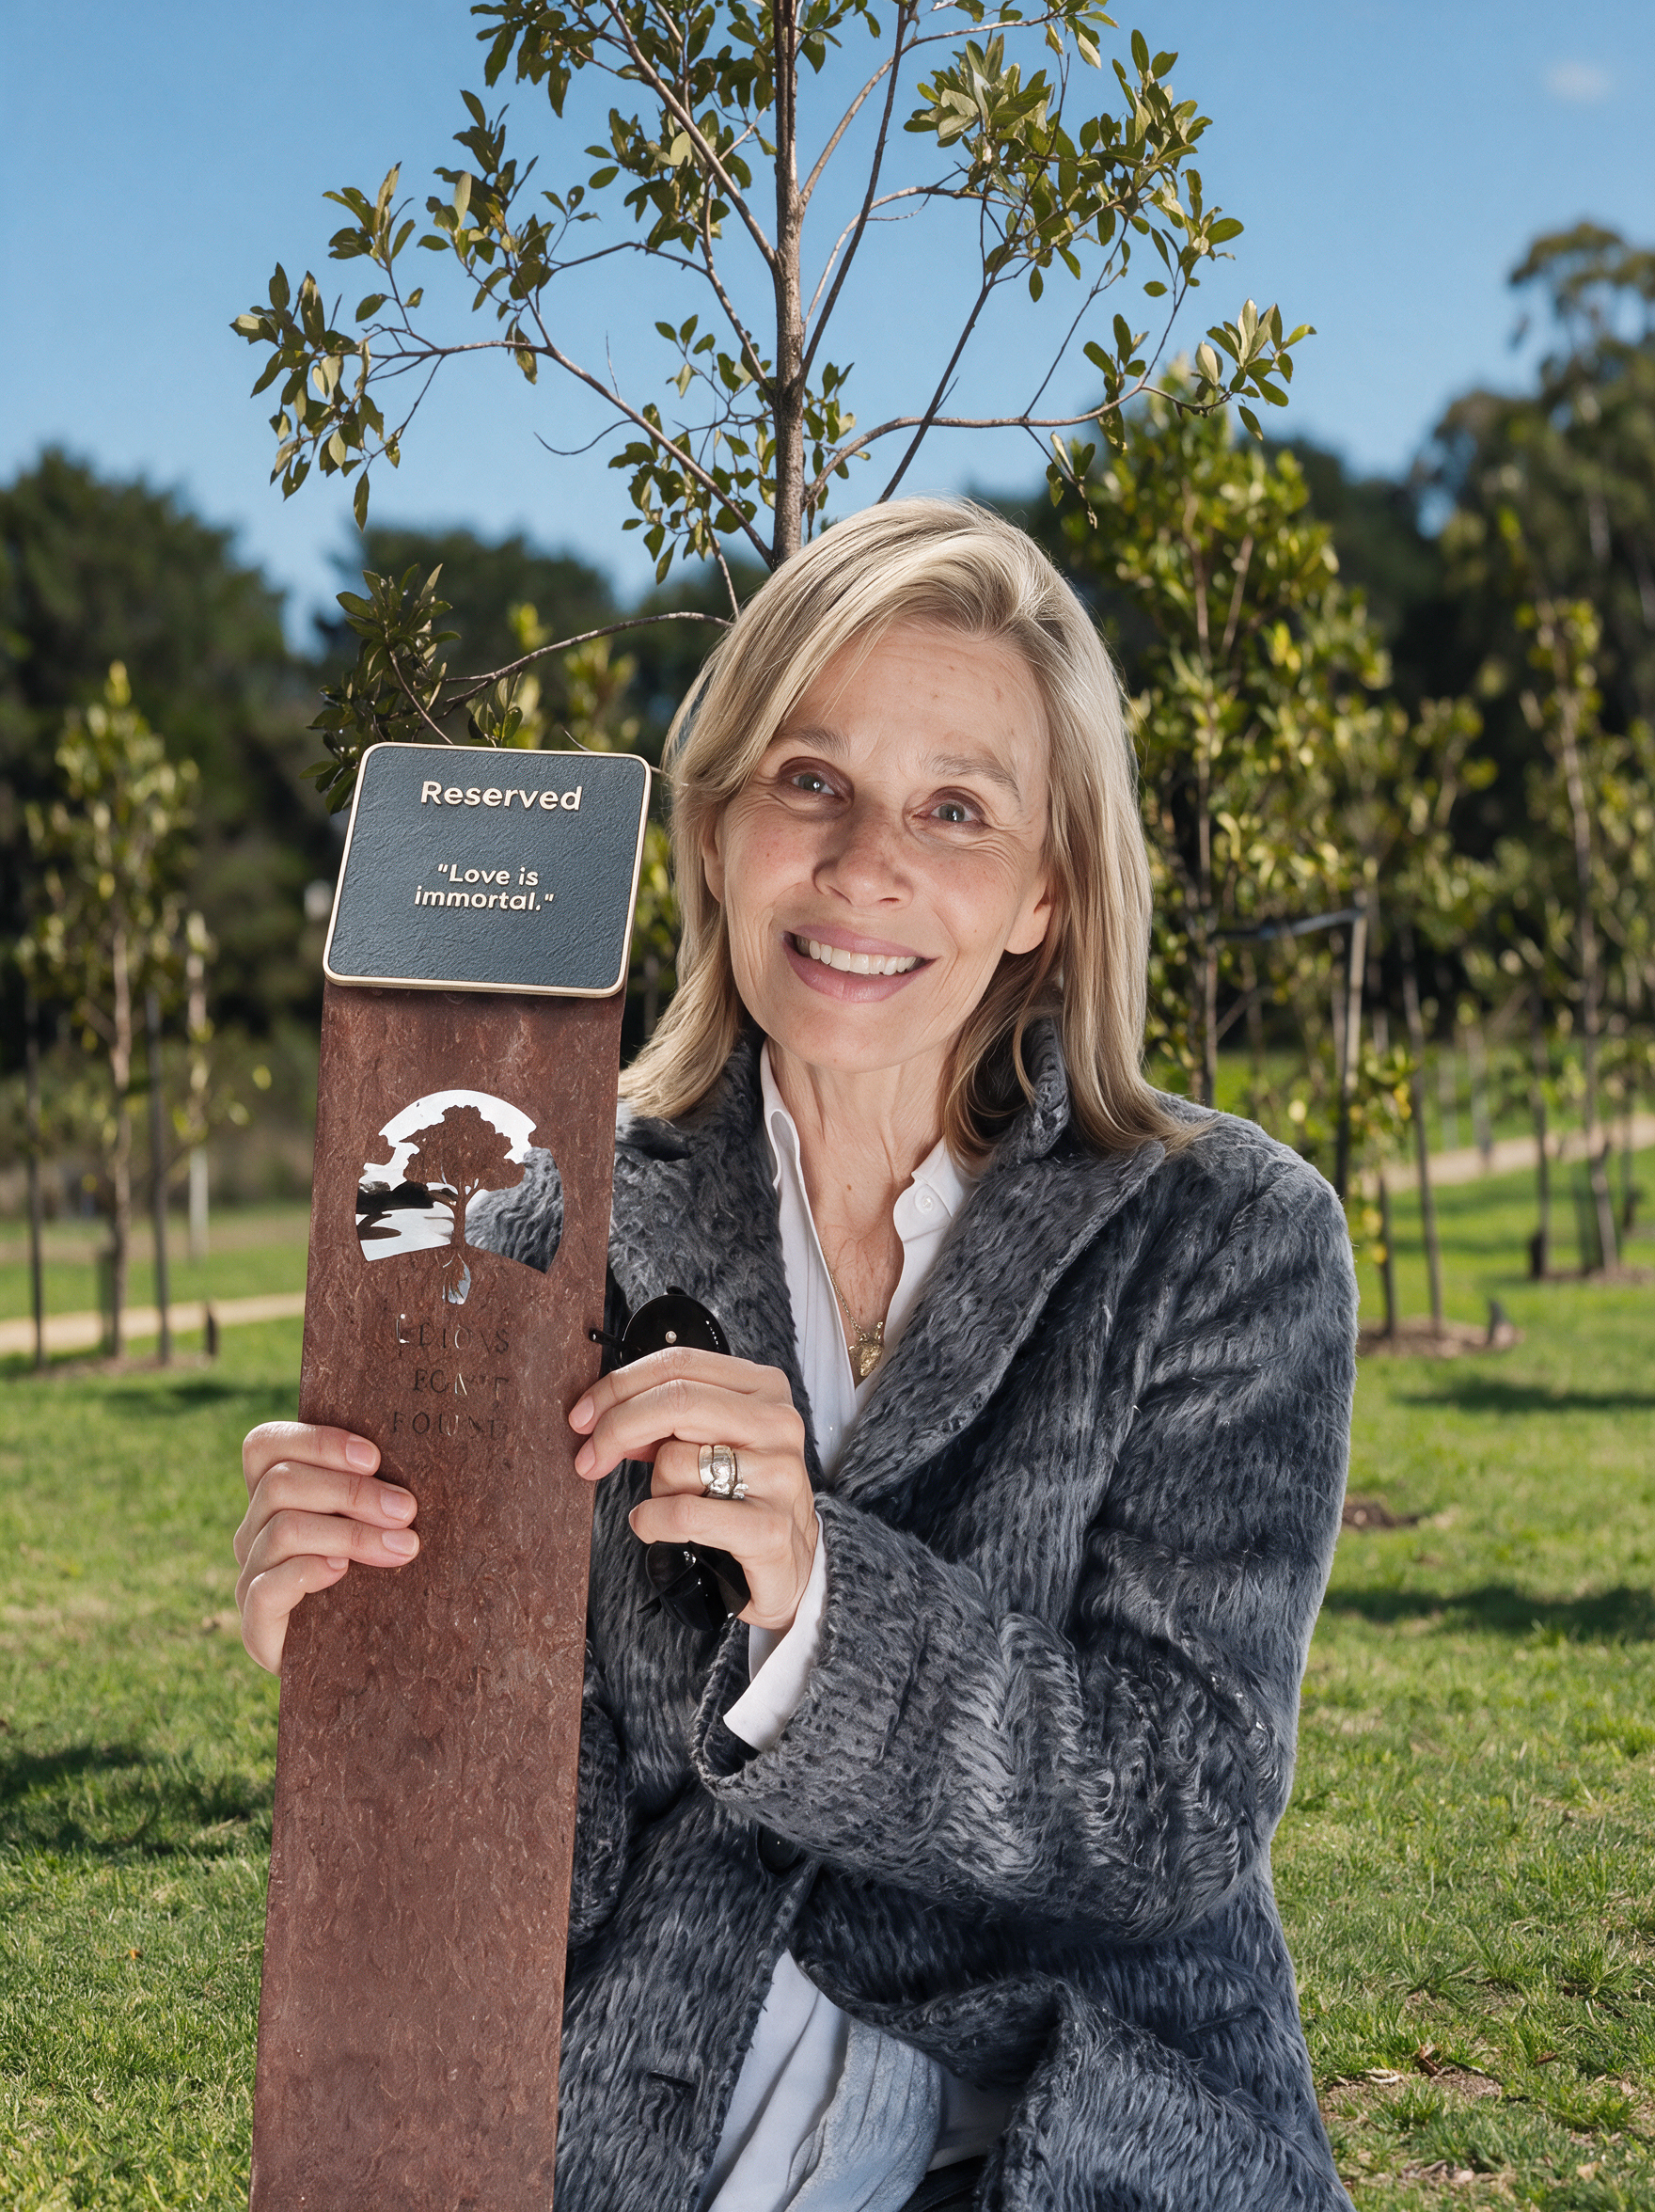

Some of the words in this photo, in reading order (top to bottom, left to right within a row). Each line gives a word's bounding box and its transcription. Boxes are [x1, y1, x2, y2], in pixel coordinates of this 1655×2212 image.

[420, 781, 582, 811] Reserved
[437, 863, 510, 886] "Love
[519, 866, 539, 887] is
[414, 886, 555, 911] immortal."
